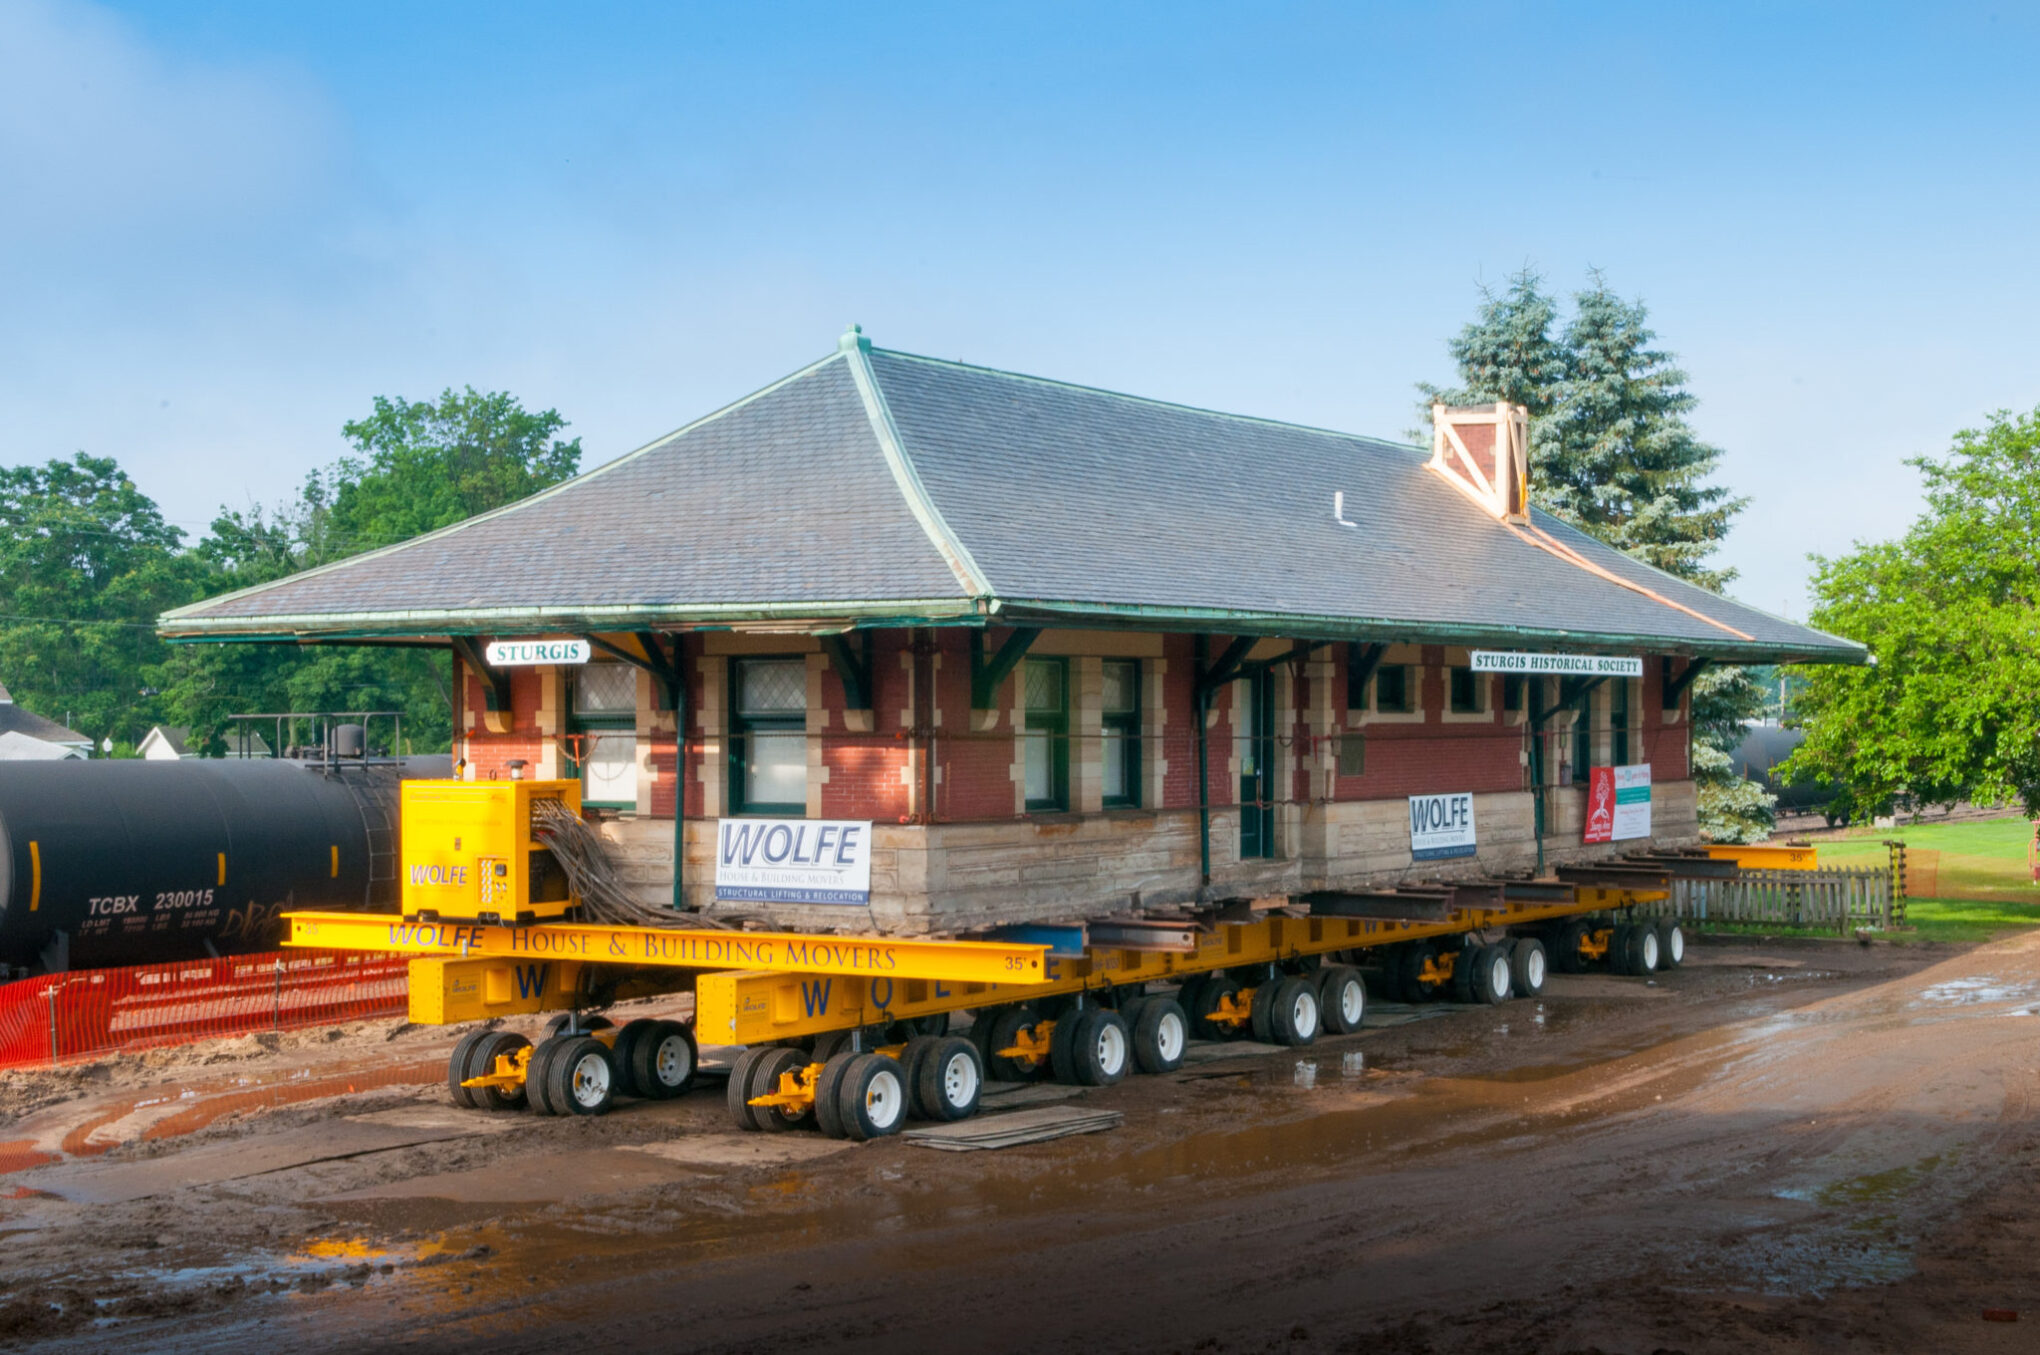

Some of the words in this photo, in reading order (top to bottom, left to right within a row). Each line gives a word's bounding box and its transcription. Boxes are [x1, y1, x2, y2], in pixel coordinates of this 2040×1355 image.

[497, 643, 579, 661] STURGIS
[1475, 655, 1526, 669] STURGIS
[1530, 657, 1594, 671] HISTORICAL
[1597, 661, 1639, 672] SOCIETY
[1411, 797, 1468, 835] WOLFE
[721, 823, 861, 868] WOLFE
[410, 864, 468, 887] WOLFE
[719, 871, 749, 883] HOUSE
[761, 873, 805, 885] BUILDING
[807, 875, 844, 886] MOVERS
[89, 895, 140, 915] TCBX
[153, 889, 214, 910] 230015
[718, 887, 768, 898] STRUCTURAL
[771, 889, 802, 899] LIFTING
[804, 890, 811, 900] &
[813, 891, 864, 902] RELOCATION
[389, 923, 486, 948] WOLFE
[512, 928, 592, 954] HOUSE
[608, 932, 627, 956] &
[645, 933, 773, 964] BUILDING
[785, 941, 897, 970] MOVERS
